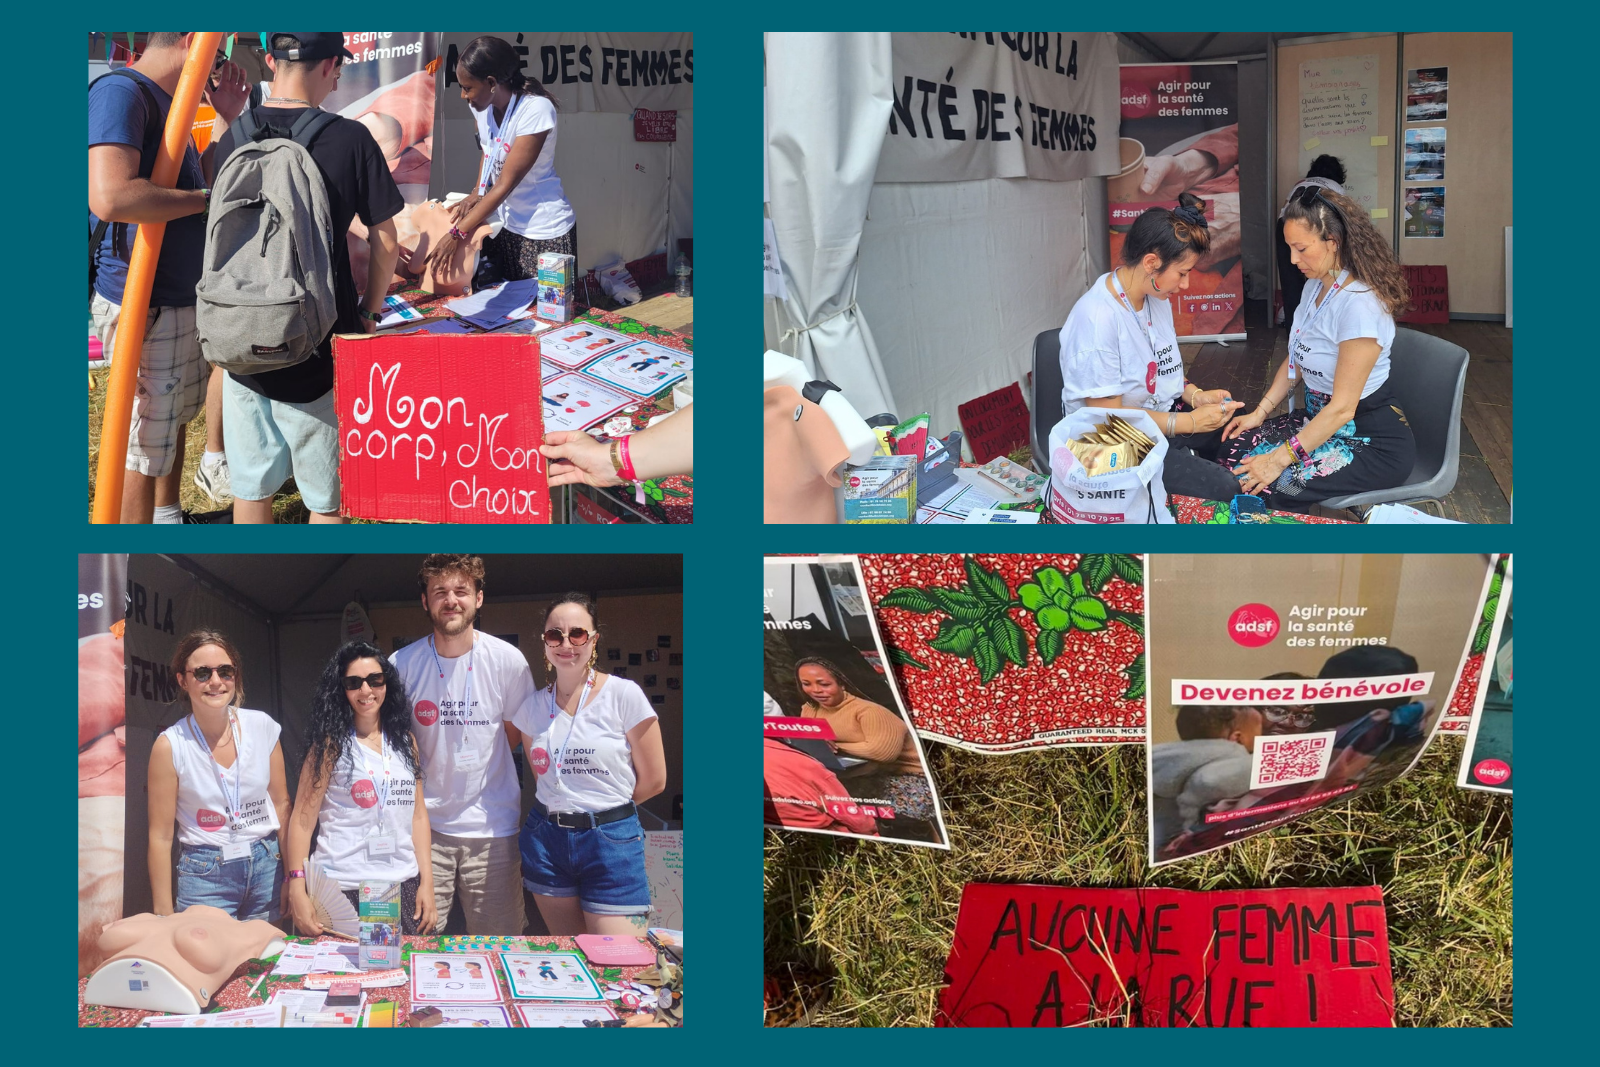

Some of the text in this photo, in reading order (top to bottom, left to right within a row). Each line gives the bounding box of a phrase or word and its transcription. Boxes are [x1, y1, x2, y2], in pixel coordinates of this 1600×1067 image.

[363, 41, 422, 62] femmes
[1055, 33, 1078, 80] LA
[540, 45, 593, 85] DES
[602, 47, 693, 87] FEMMES
[1157, 80, 1211, 93] Agir pour
[1121, 94, 1148, 104] adsf
[1158, 93, 1204, 104] la santé
[1158, 106, 1228, 117] des femmes
[972, 89, 1024, 142] DES
[1029, 102, 1097, 152] FEMMES
[1156, 344, 1172, 360] pour
[353, 362, 474, 430] Mon
[985, 413, 1002, 432] LES
[457, 414, 542, 473] Mon
[1067, 508, 1074, 516] 01
[78, 592, 104, 610] es
[153, 592, 174, 636] LA
[1288, 604, 1368, 620] Agir pour
[764, 620, 812, 630] mmes
[1235, 619, 1354, 632] adsf la santé
[1286, 634, 1388, 648] des femmes
[1180, 678, 1426, 701] Devenez bénévole
[418, 709, 436, 718] adsf
[764, 722, 822, 732] rToutes
[1038, 728, 1092, 738] GUARANTEED
[573, 748, 596, 758] pour
[564, 757, 590, 765] santé
[1479, 768, 1506, 777] adsf
[400, 779, 416, 788] pou
[354, 788, 413, 799] adsf santé
[246, 798, 267, 810] pour
[1227, 802, 1288, 818] d'informations
[200, 814, 222, 823] adsf
[990, 898, 1384, 968] AUCUNE FEMME
[1032, 970, 1064, 1028] A
